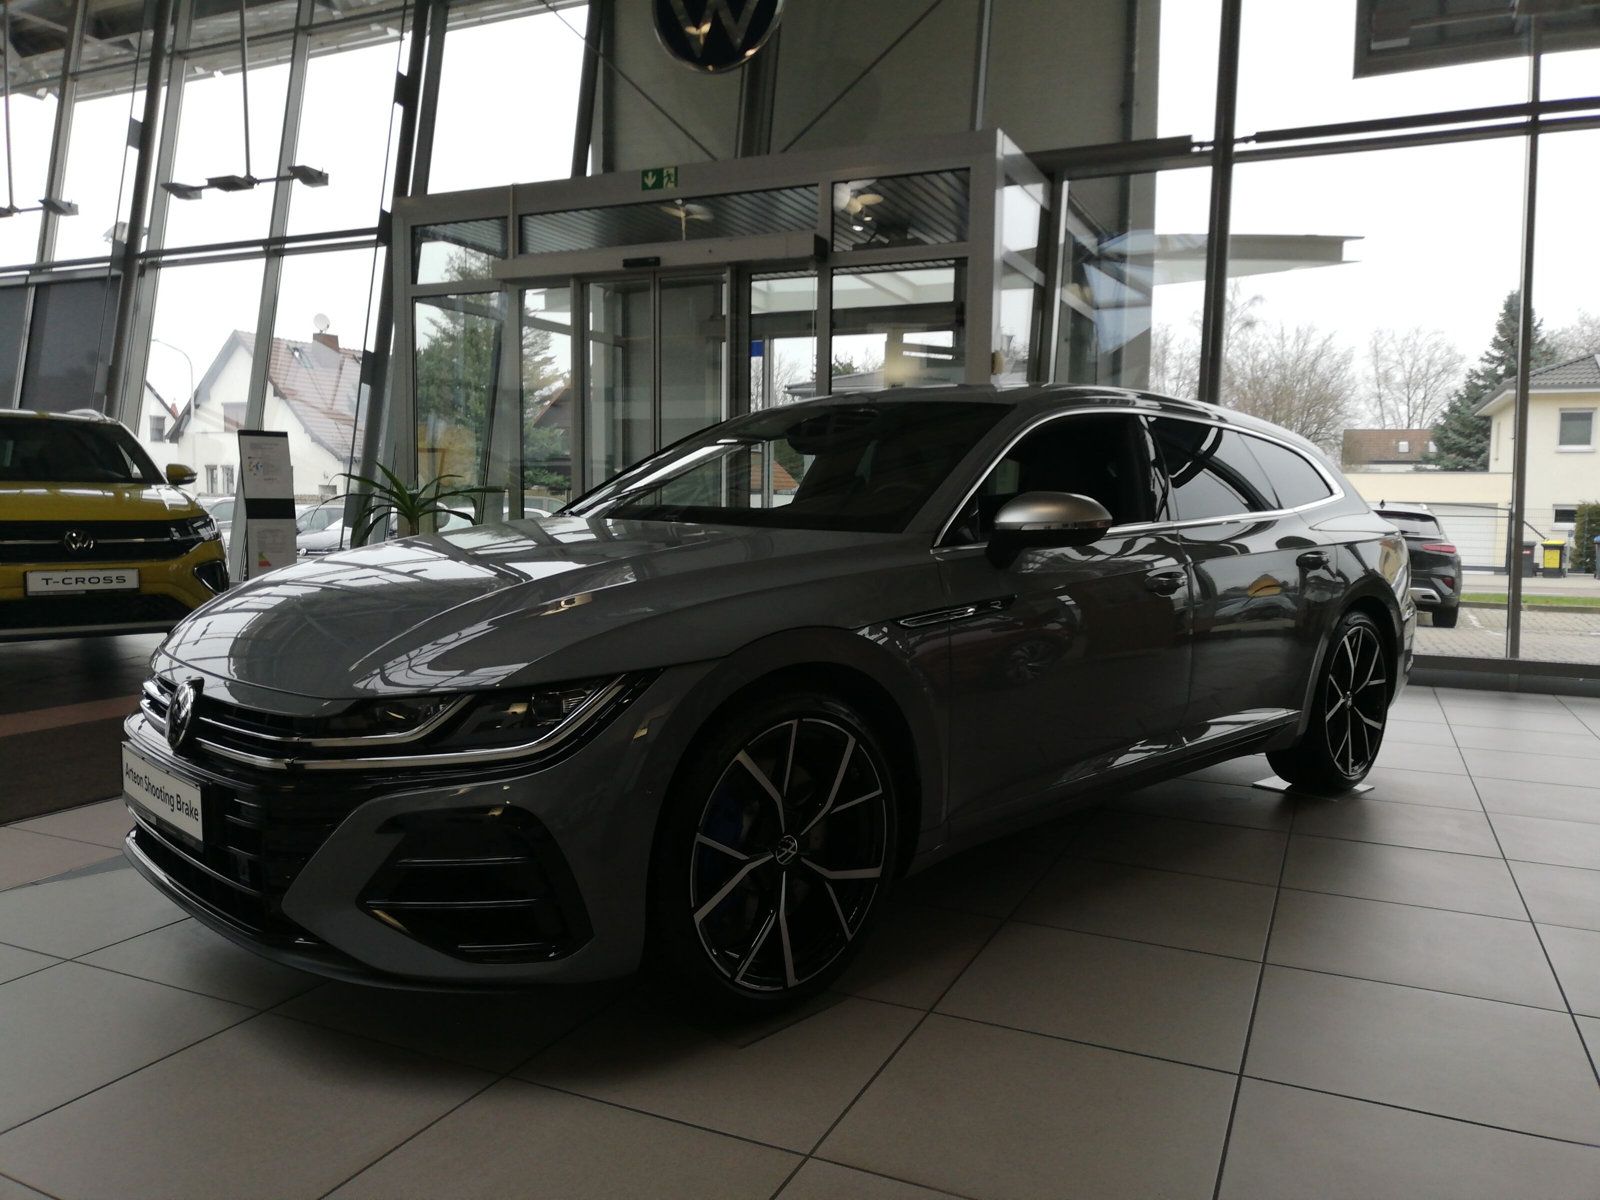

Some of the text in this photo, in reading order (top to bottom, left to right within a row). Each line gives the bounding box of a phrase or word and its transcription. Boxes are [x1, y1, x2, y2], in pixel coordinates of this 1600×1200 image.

[41, 575, 127, 586] T-CROSS
[125, 763, 143, 788] Arteon
[144, 775, 175, 812] Shooting
[176, 794, 199, 822] Brake
